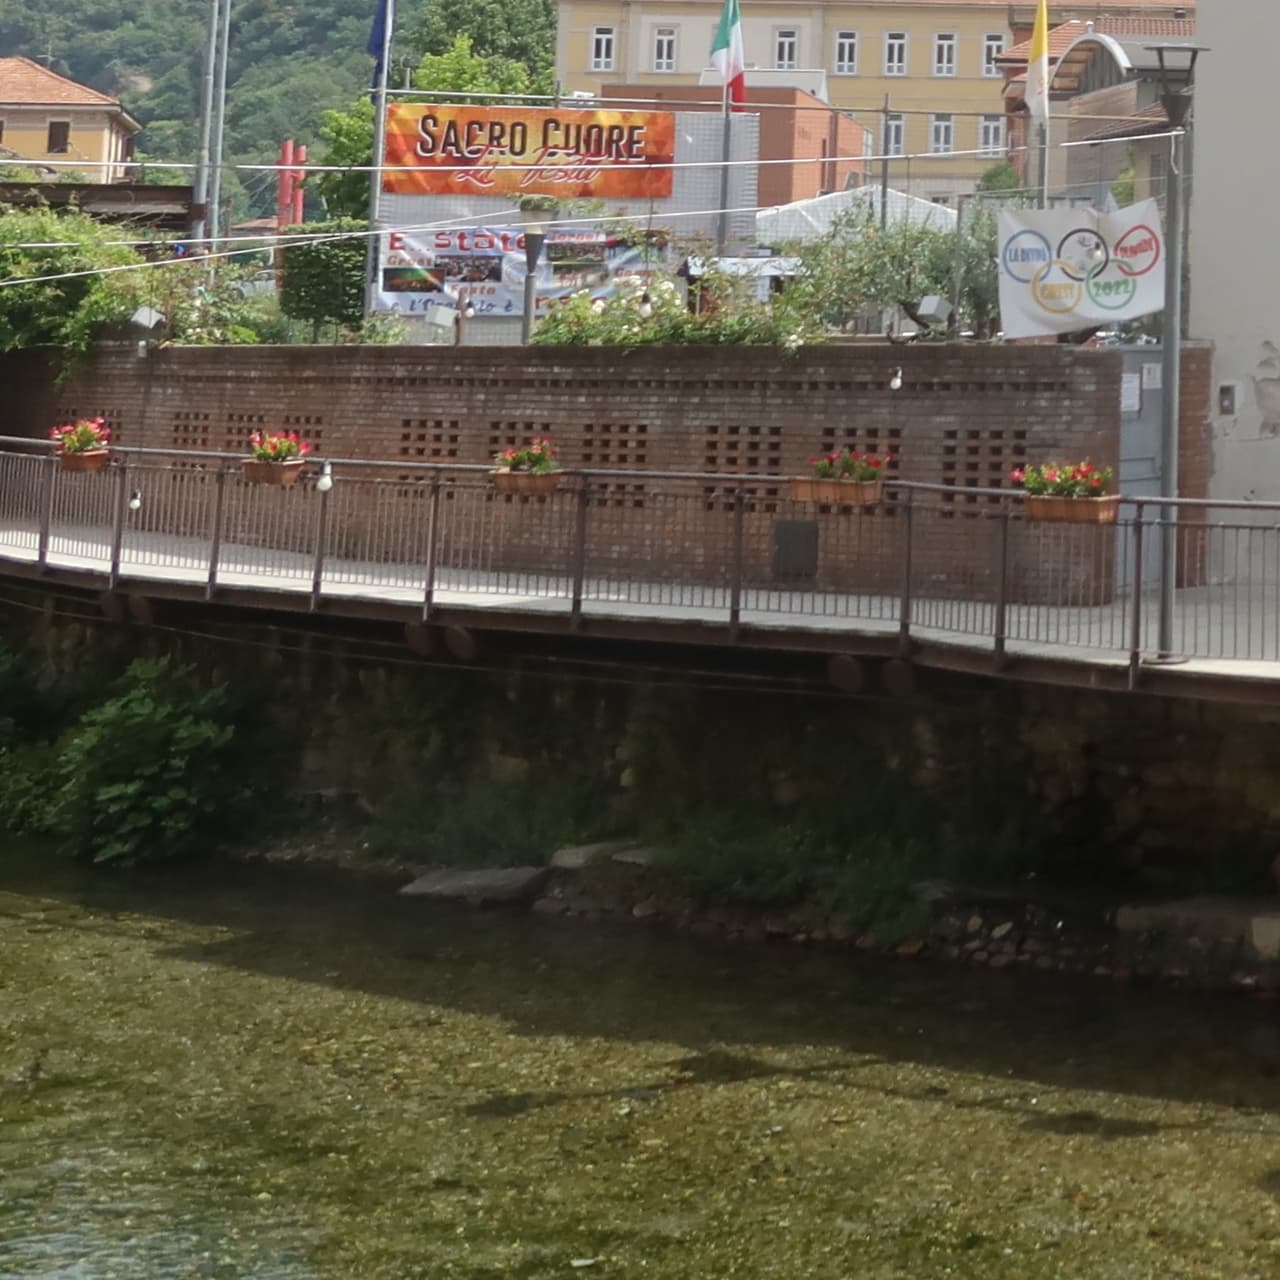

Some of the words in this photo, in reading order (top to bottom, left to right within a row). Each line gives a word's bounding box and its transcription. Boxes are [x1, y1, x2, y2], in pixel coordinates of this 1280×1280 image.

[416, 114, 528, 158] SACRO
[541, 118, 648, 162] CUORE
[1093, 279, 1131, 297] 2022
